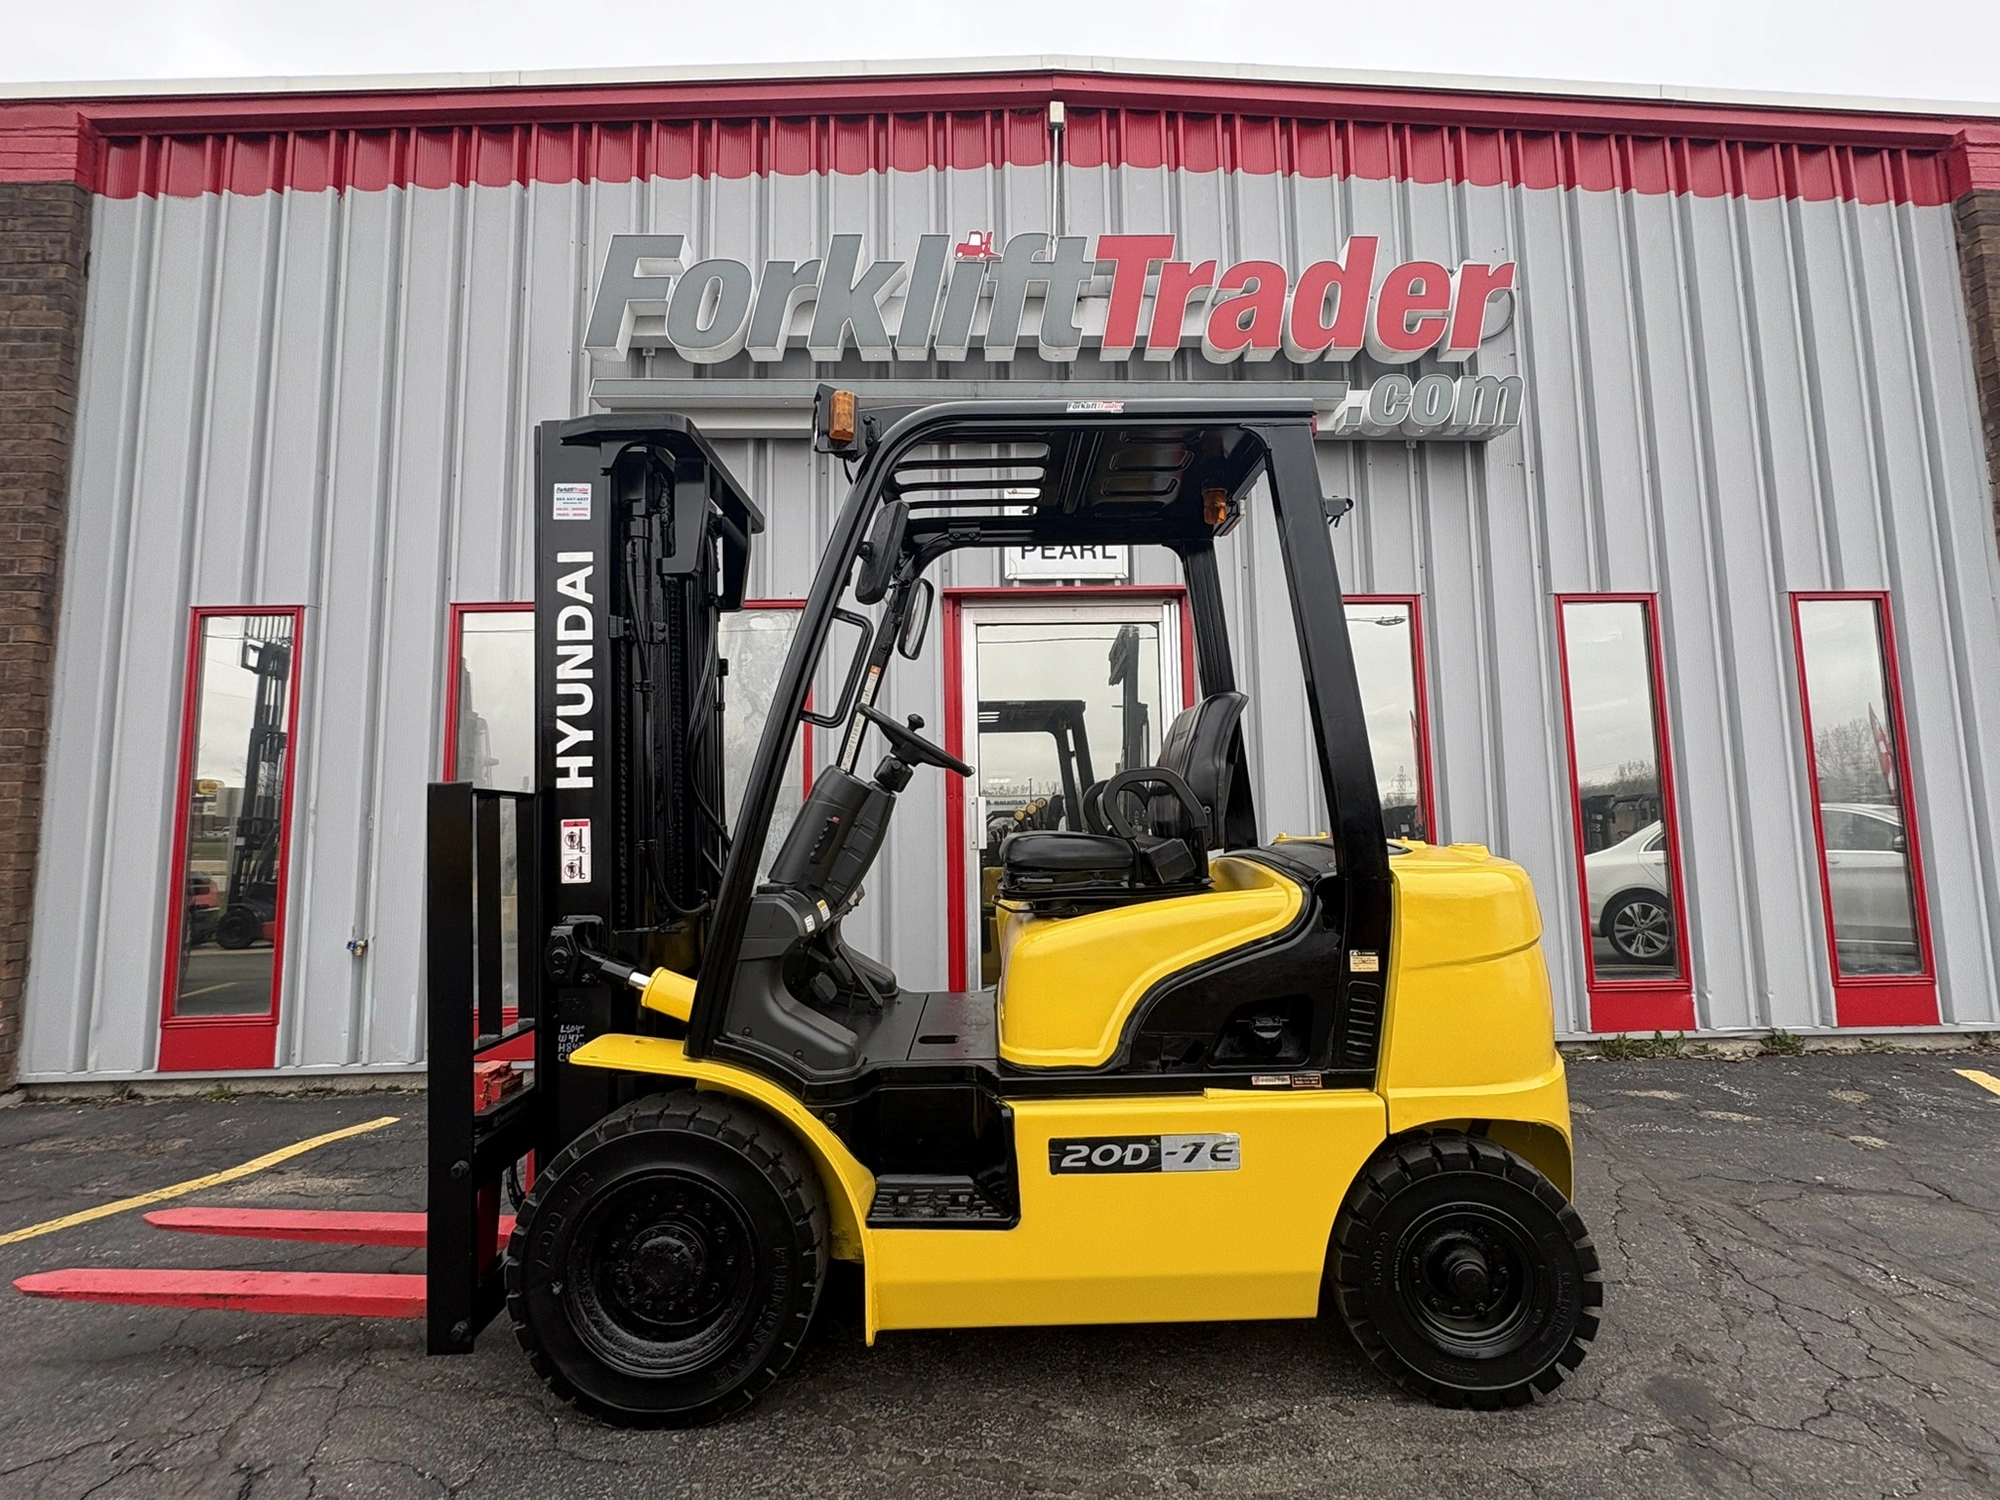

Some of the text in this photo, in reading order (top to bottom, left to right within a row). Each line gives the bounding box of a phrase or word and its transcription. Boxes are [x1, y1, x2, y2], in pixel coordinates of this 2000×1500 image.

[583, 231, 1517, 364] ForkliftTrader
[1336, 373, 1526, 436] .com
[1020, 545, 1118, 560] PEARL
[556, 551, 594, 789] HYUNDAI
